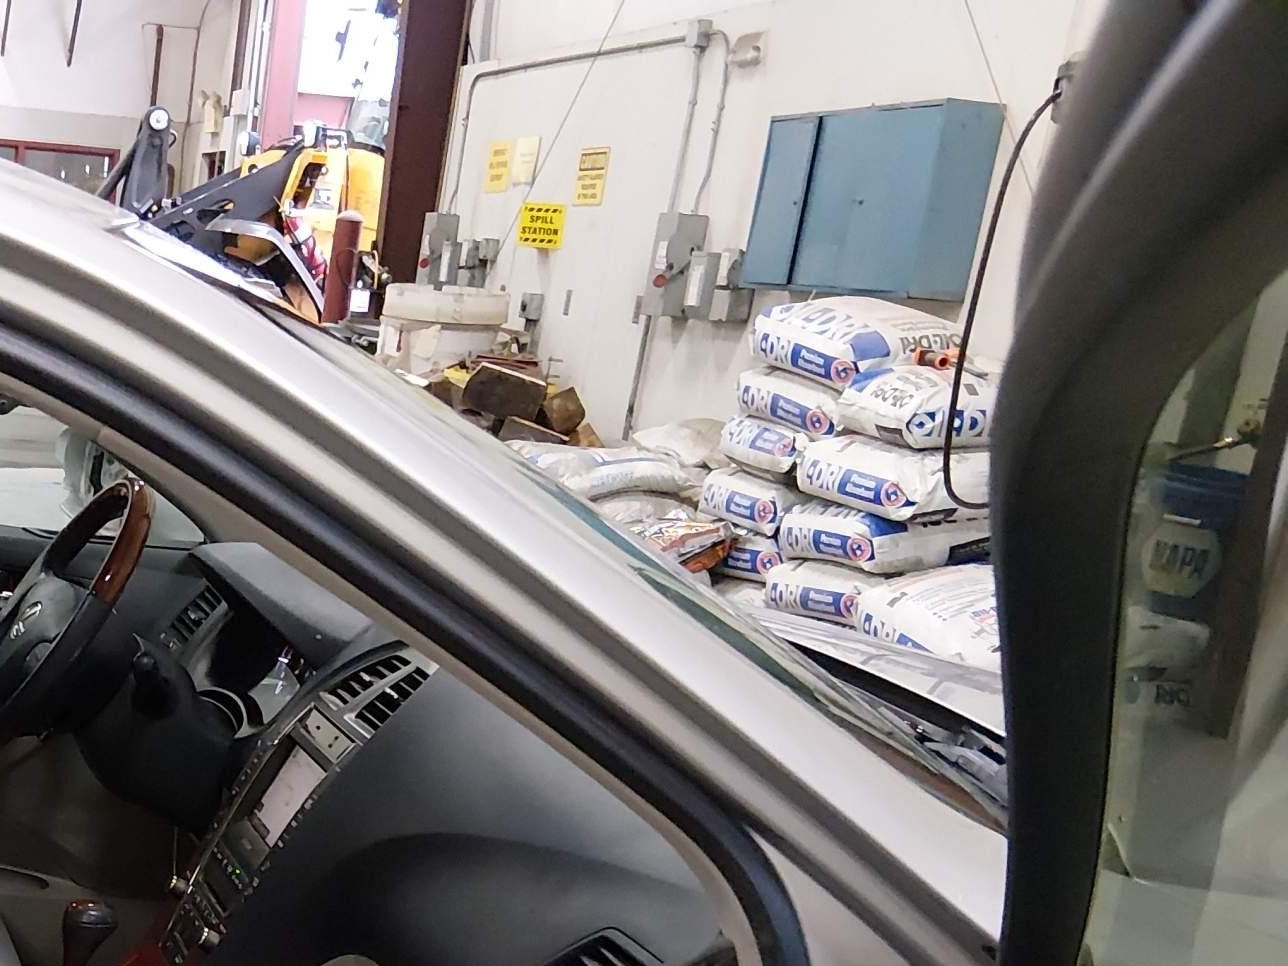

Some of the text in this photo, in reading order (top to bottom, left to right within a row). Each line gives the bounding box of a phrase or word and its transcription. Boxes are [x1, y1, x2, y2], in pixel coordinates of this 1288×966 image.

[529, 215, 554, 225] SPILL
[520, 226, 559, 236] STATION
[1149, 539, 1210, 579] NAPA
